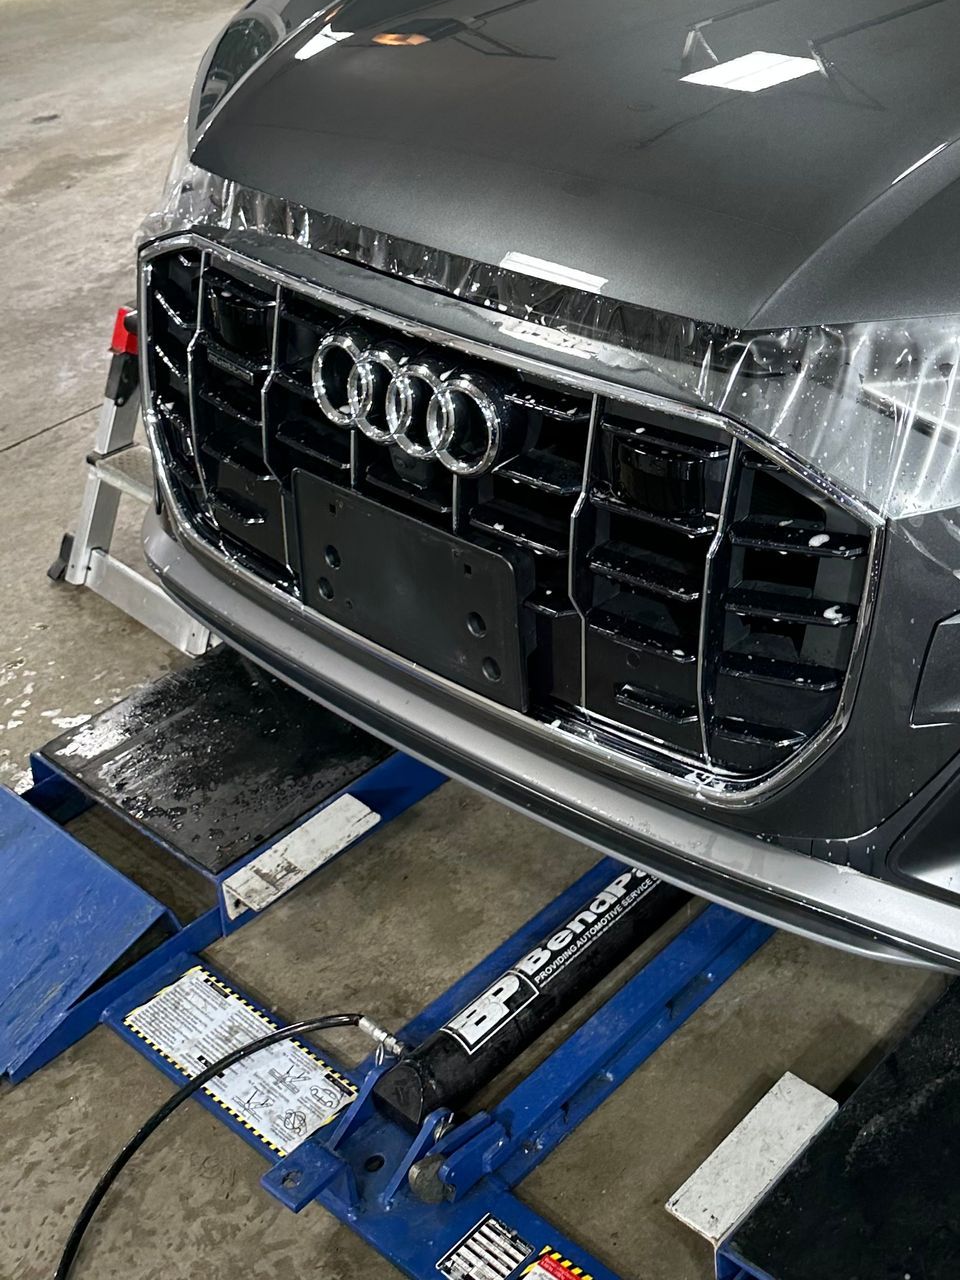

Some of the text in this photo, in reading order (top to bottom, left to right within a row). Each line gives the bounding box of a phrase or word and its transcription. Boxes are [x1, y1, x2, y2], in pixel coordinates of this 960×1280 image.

[534, 877, 651, 984] PROVIDING AUTOMOTIVE SERVICE
[447, 974, 520, 1046] BP
